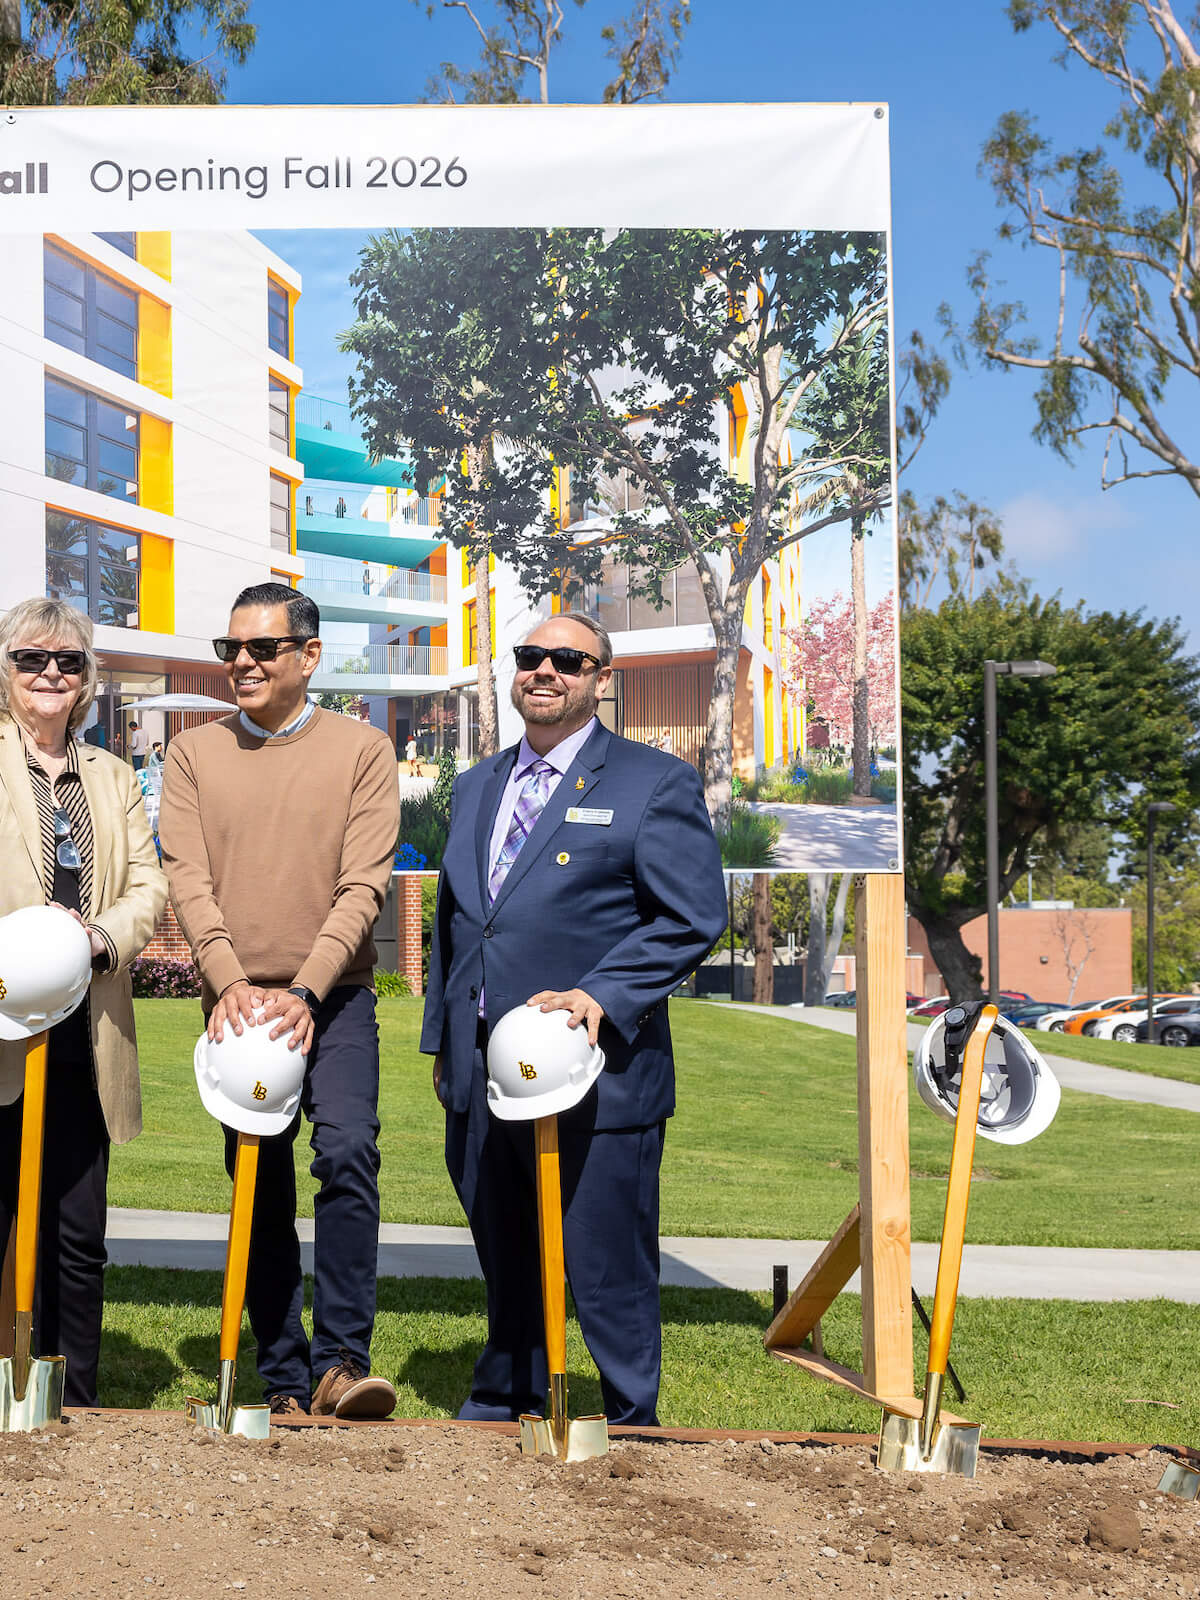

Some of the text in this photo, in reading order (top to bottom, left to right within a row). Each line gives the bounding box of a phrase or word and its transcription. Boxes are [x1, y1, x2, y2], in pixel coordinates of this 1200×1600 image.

[89, 158, 268, 202] Opening
[284, 157, 352, 190] Fall
[365, 156, 468, 189] 2026
[518, 1061, 538, 1081] LB
[251, 1080, 268, 1102] LB
